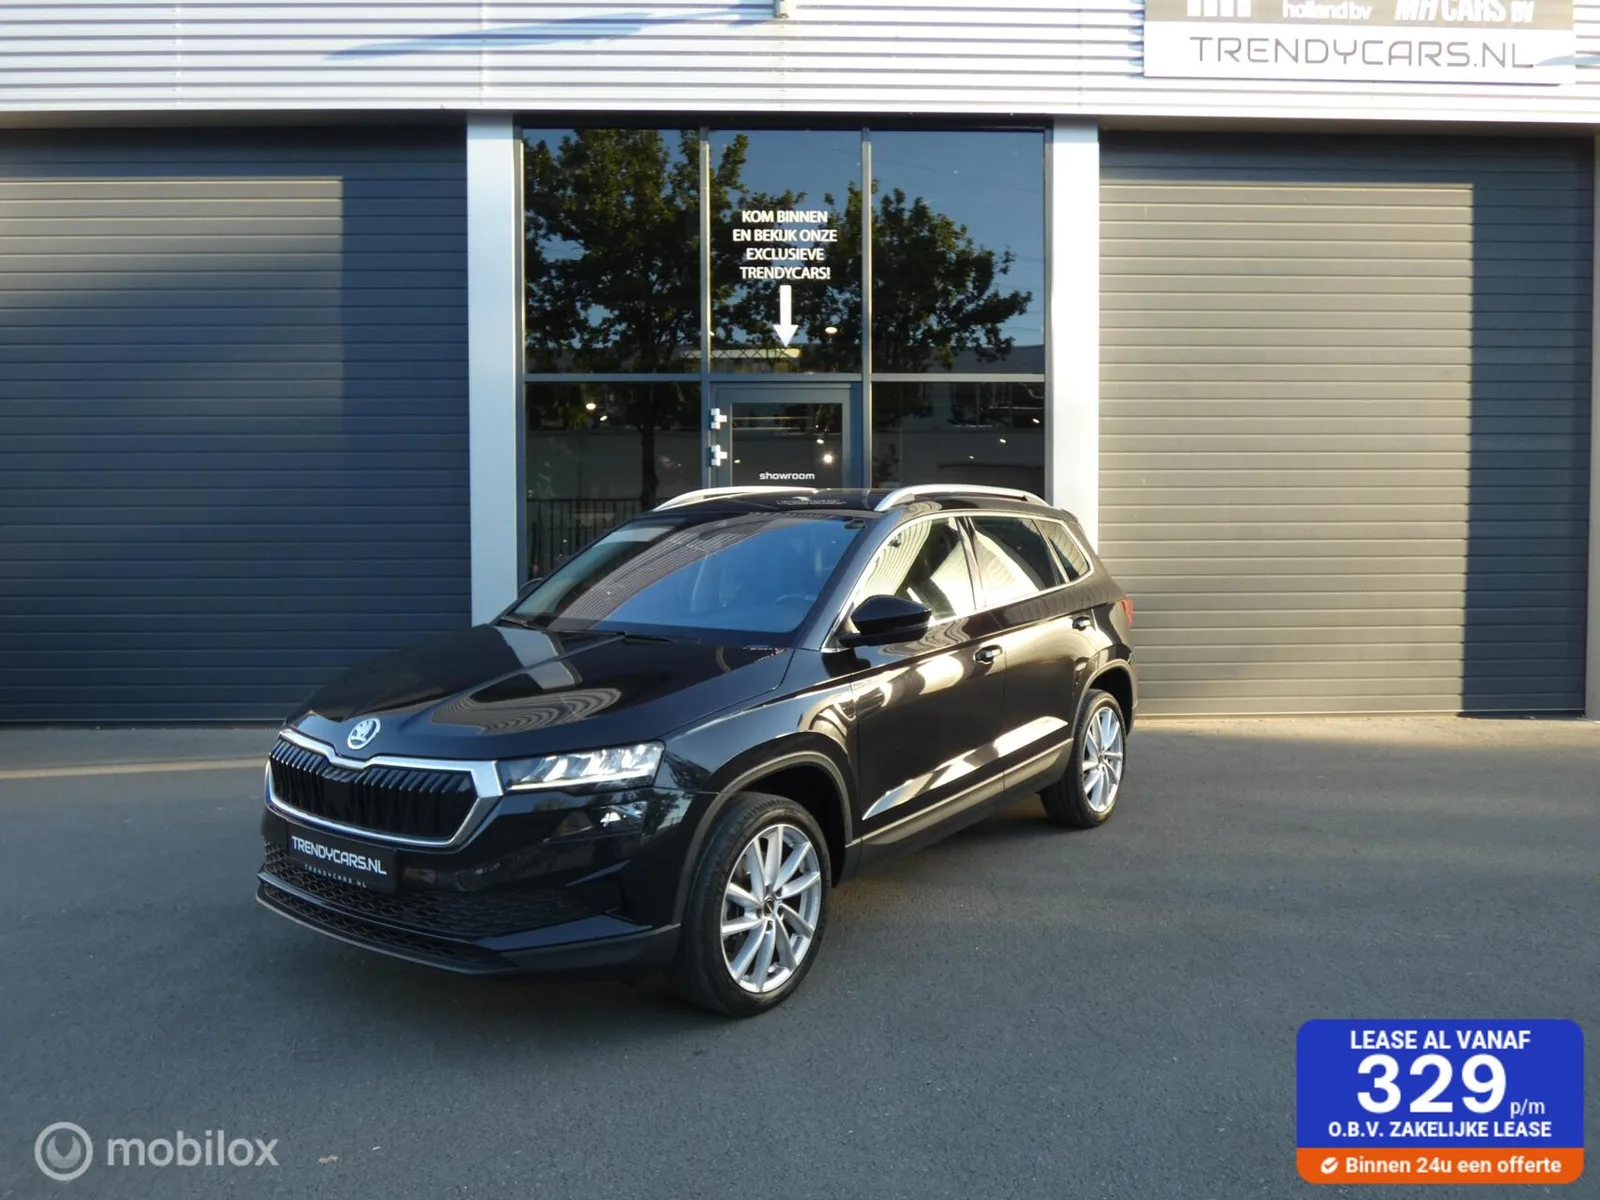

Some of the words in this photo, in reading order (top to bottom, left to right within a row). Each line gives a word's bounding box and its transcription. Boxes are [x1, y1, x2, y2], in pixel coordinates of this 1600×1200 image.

[1441, 0, 1507, 23] CARS
[1190, 37, 1534, 69] TRENDYCARS.NL
[742, 210, 774, 223] KOM
[776, 210, 828, 223] BINNEN
[732, 229, 751, 242] EN
[754, 229, 797, 242] BEKIJK
[799, 229, 838, 242] ONZE
[746, 248, 825, 261] EXCLUSIEVE
[739, 266, 831, 280] TRENDYCARS!
[759, 471, 815, 480] showroom
[291, 835, 387, 875] TRENDYCARS.NL
